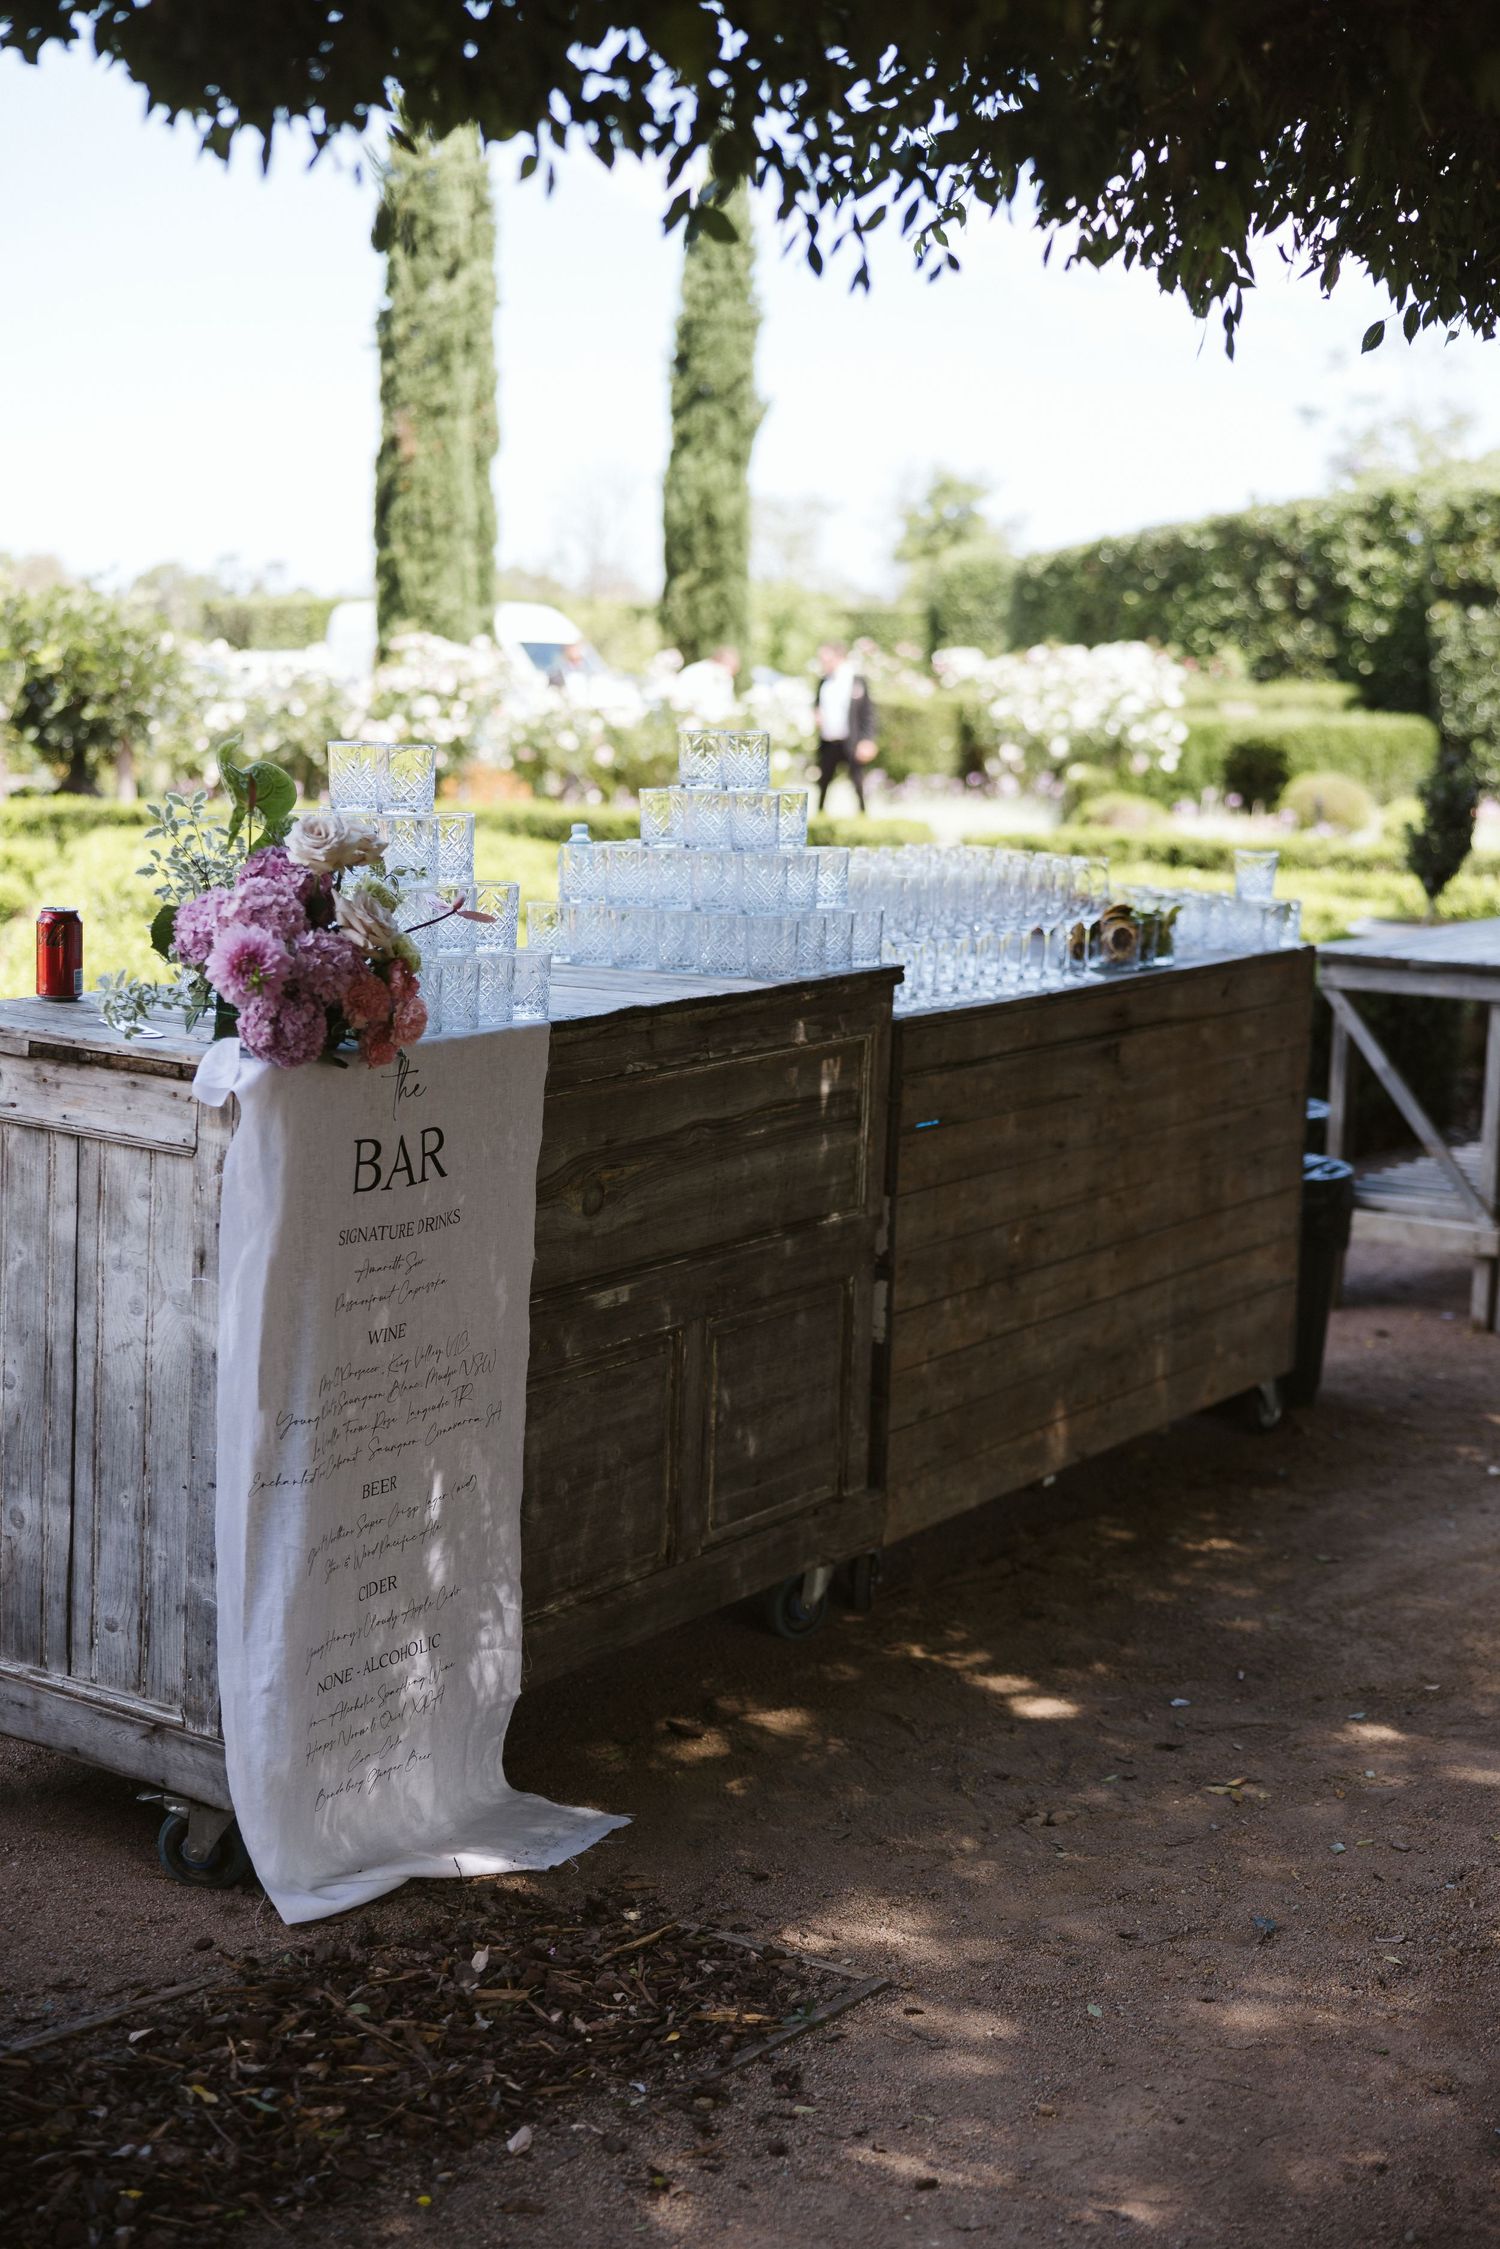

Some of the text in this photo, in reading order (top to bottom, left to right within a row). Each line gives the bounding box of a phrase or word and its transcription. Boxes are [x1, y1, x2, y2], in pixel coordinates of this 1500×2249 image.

[381, 1055, 427, 1121] the
[353, 1127, 448, 1194] BAR
[338, 1208, 461, 1246] SIGNATURE DRINKS
[368, 1323, 407, 1345] WINE
[276, 1410, 321, 1440] Young
[362, 1476, 398, 1500] BEER
[358, 1575, 398, 1602] CIDER
